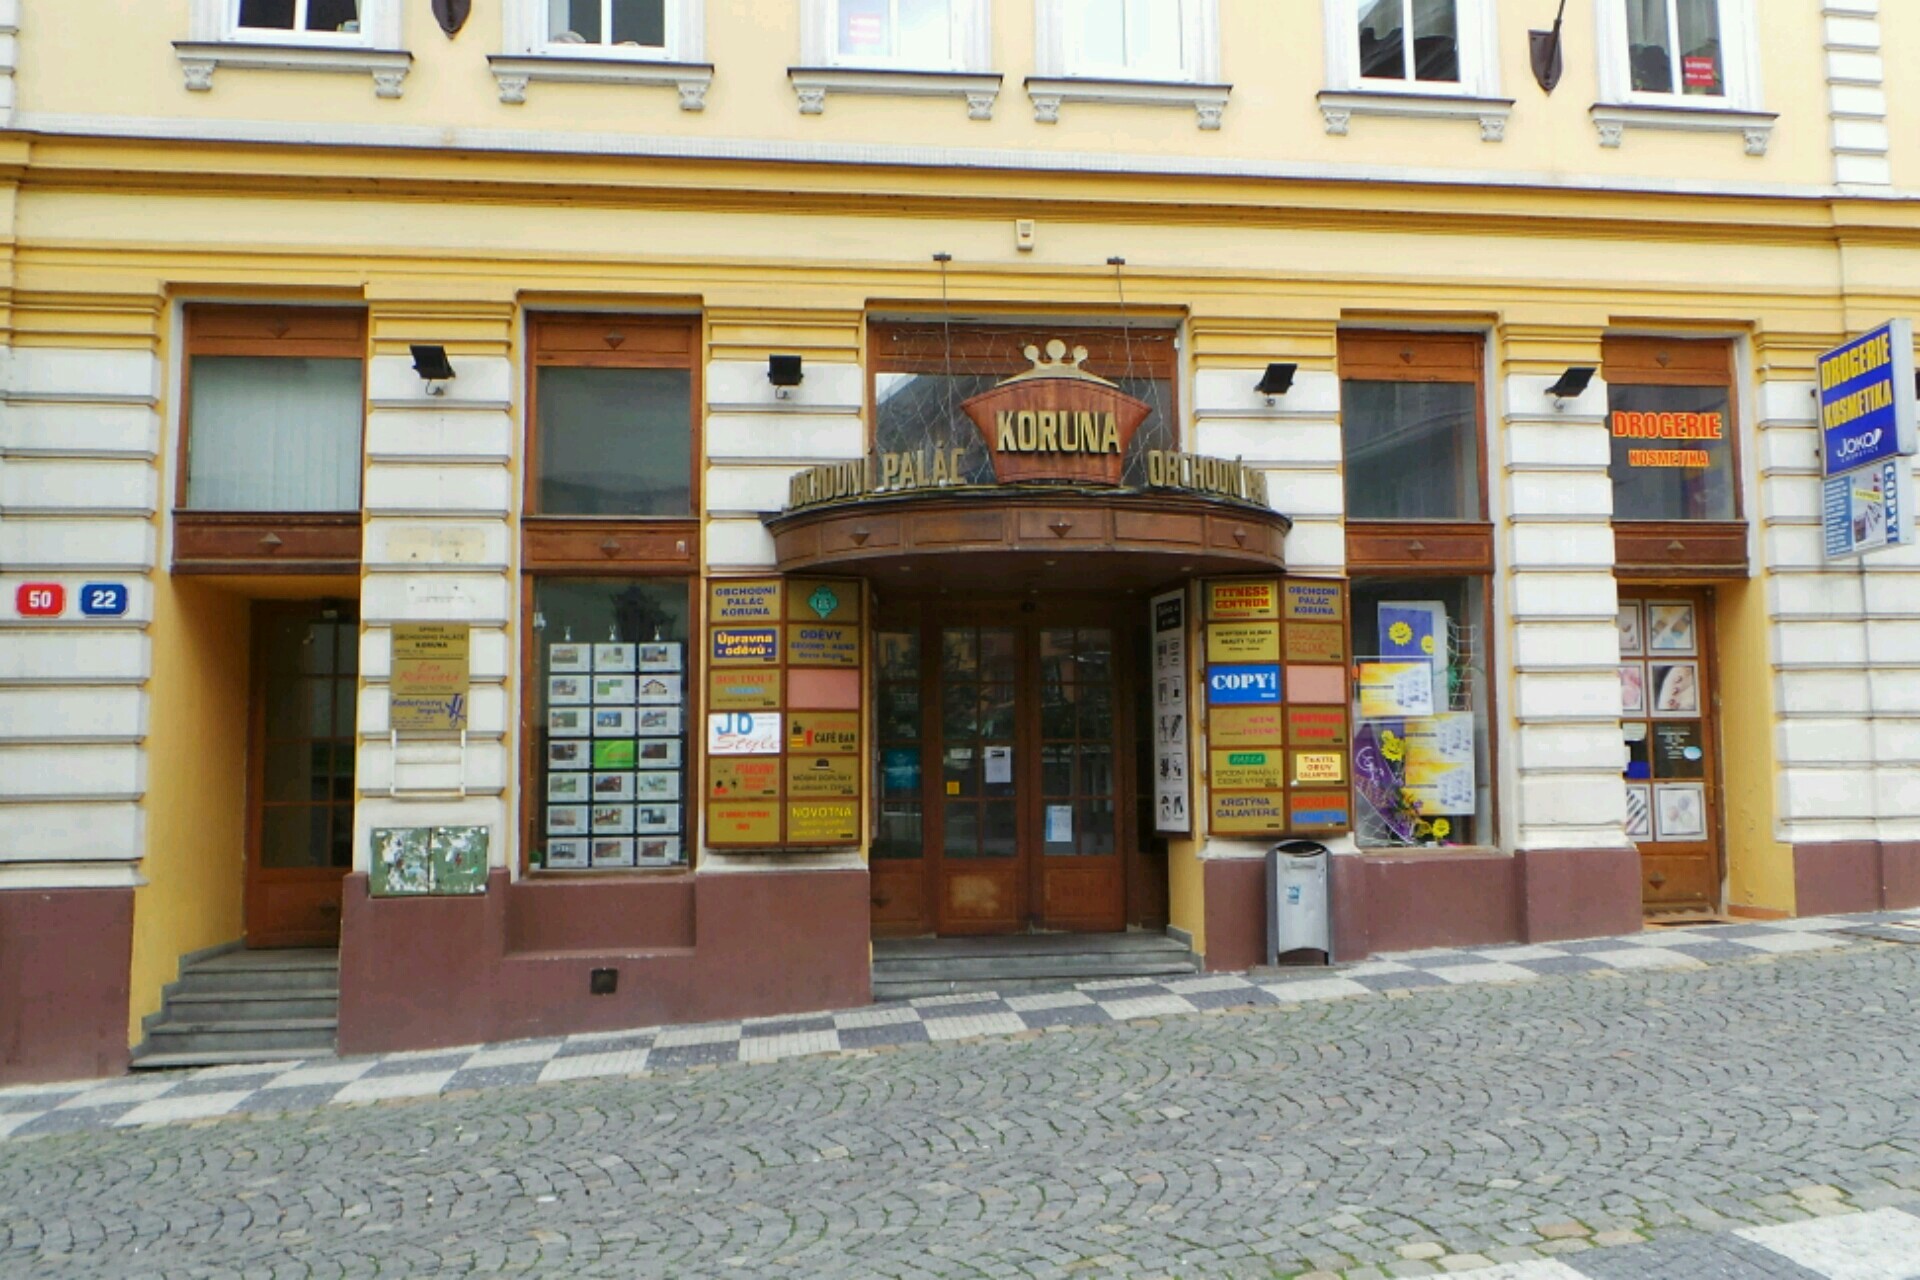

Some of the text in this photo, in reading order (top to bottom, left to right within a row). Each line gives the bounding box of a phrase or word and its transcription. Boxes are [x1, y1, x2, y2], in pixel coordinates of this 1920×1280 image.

[1822, 333, 1890, 391] DROGERIE
[1824, 379, 1892, 430] KOSMETIKA
[1612, 411, 1722, 440] DROGERIE
[996, 410, 1121, 454] KORUNA
[1629, 450, 1709, 467] KOSMETIKA
[883, 440, 967, 490] PALÁC
[1148, 450, 1243, 498] OBCHODNÍ
[715, 586, 777, 596] OBCHODNÍ
[1215, 586, 1269, 597] FITNESS
[1288, 586, 1339, 596] OBCHODNÍ
[28, 590, 52, 608] 50
[91, 590, 117, 609] 22
[727, 597, 765, 606] PALÁC
[1215, 598, 1270, 609] CENTRUM
[1298, 596, 1330, 605] PALÁC
[721, 608, 770, 617] KORUNA
[1294, 606, 1335, 615] KORUNA
[717, 631, 773, 646] Úpravna
[801, 628, 842, 640] ODĚVY
[725, 644, 766, 656] oděvů
[814, 731, 837, 744] CAFÉ
[1221, 796, 1270, 807] KRISTÝNA
[1216, 808, 1280, 818] GALANTERIE
